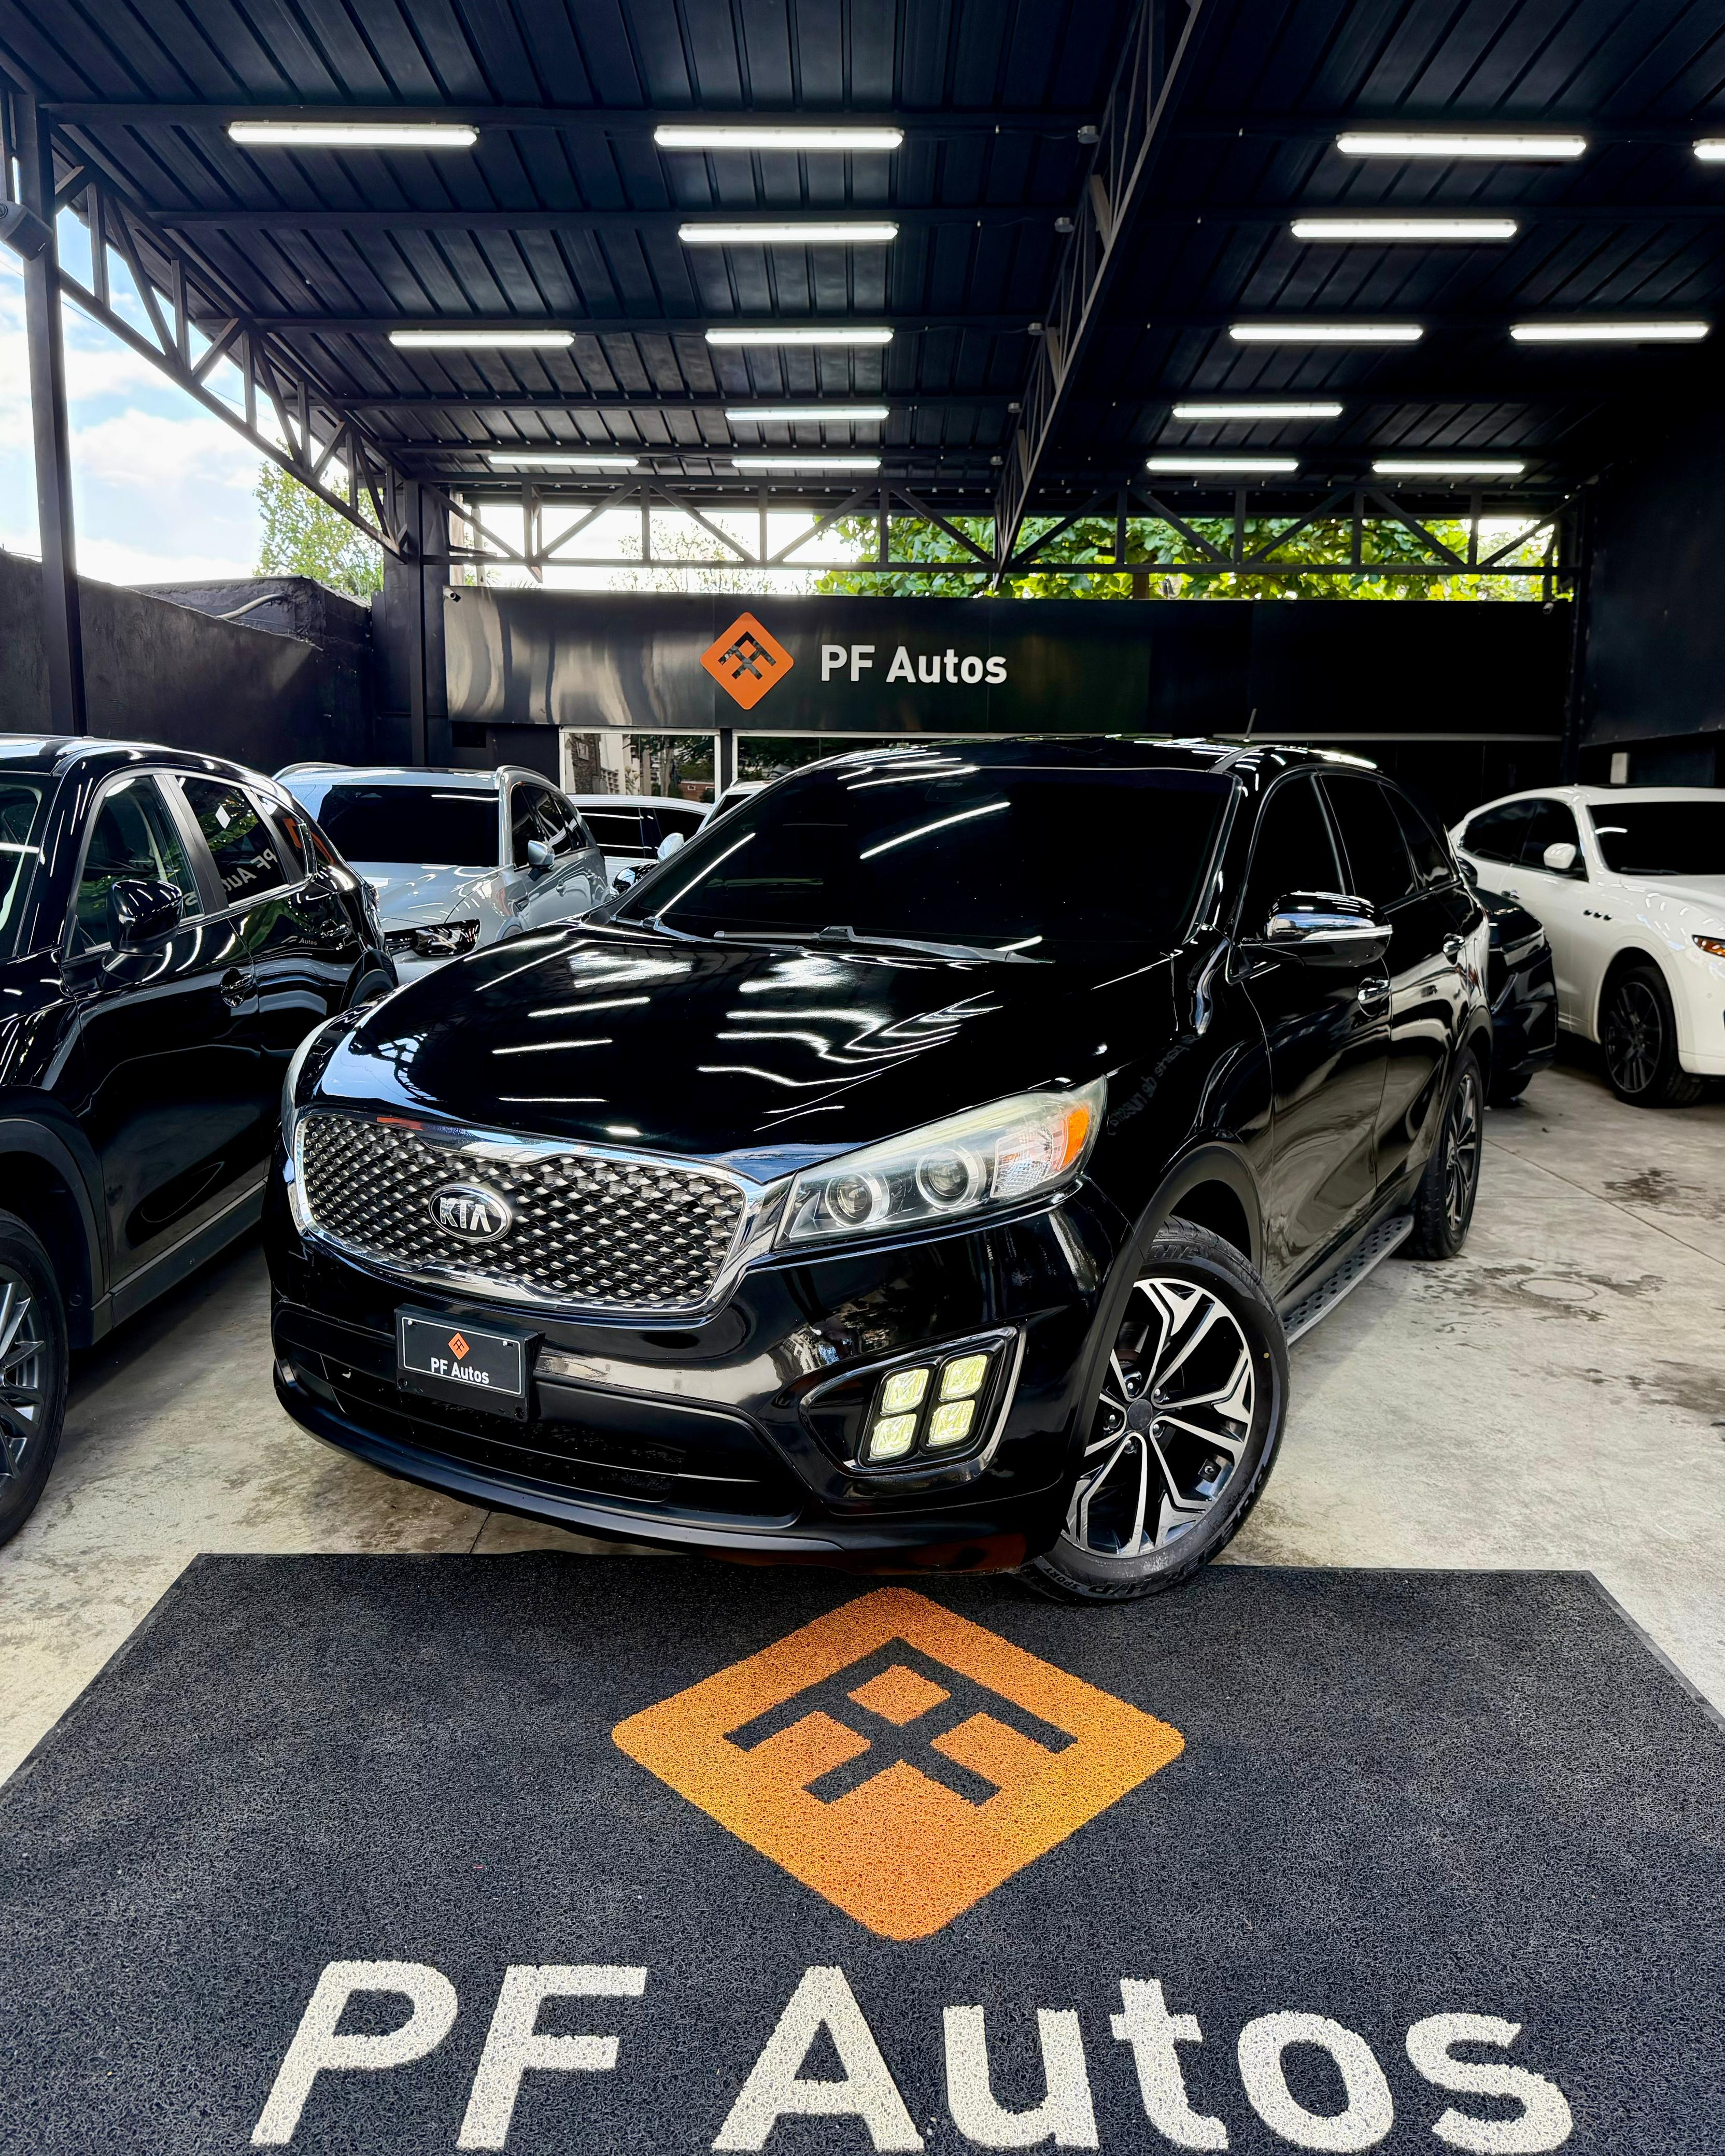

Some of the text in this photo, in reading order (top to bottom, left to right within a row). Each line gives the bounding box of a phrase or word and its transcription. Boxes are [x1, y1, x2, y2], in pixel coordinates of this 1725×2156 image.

[821, 644, 1008, 684] PF Autos
[298, 937, 318, 946] Autos
[440, 1196, 492, 1233] KIA
[431, 1356, 490, 1385] PF Autos
[1042, 1567, 1080, 1590] SPORT
[1088, 1577, 1152, 1595] H/P
[250, 1960, 1573, 2154] PF Autos
